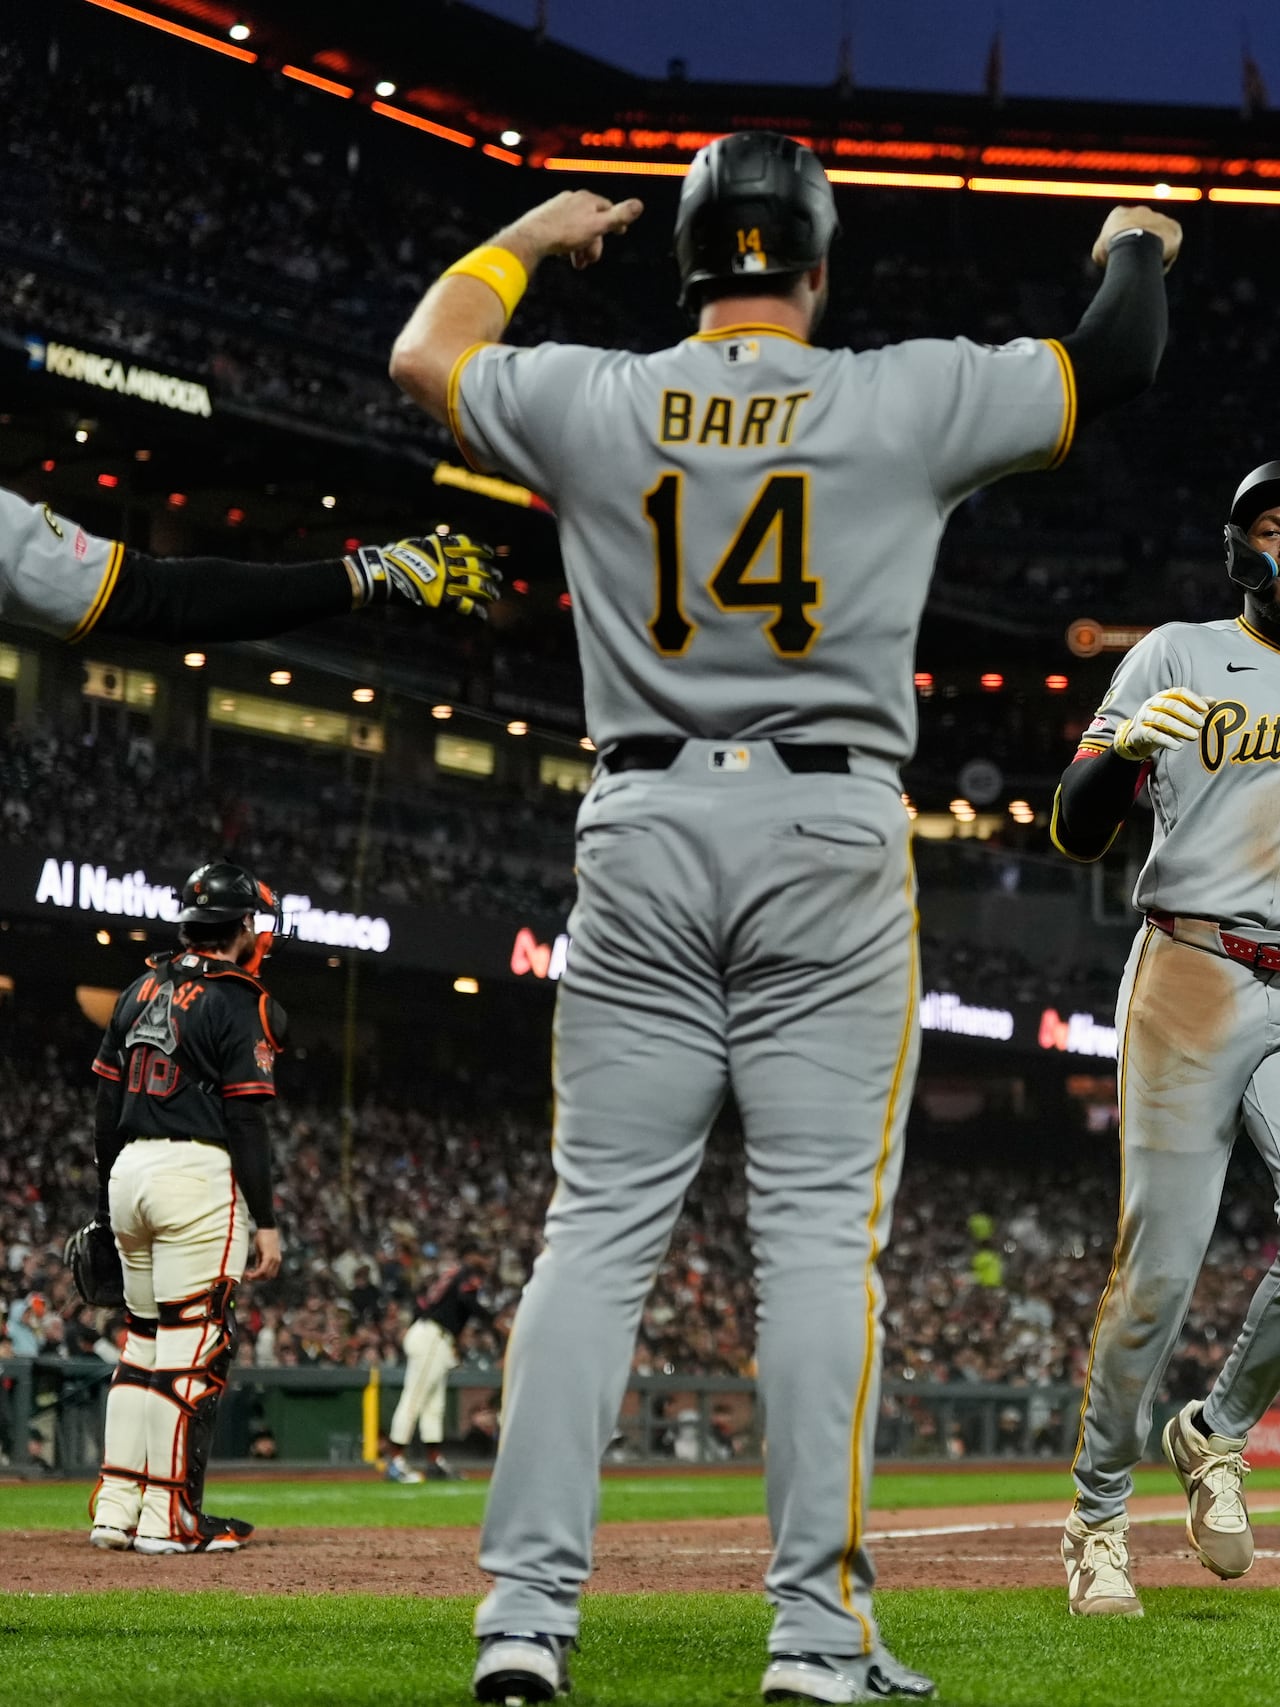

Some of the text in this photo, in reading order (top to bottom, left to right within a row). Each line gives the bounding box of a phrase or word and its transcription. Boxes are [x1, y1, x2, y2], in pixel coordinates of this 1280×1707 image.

[737, 228, 761, 254] 14
[46, 341, 213, 418] KONICA MINOLTA
[659, 389, 812, 449] BART
[642, 471, 823, 658] 14
[35, 857, 76, 908] AI
[282, 893, 391, 953] Finance
[135, 976, 206, 1012] HSE
